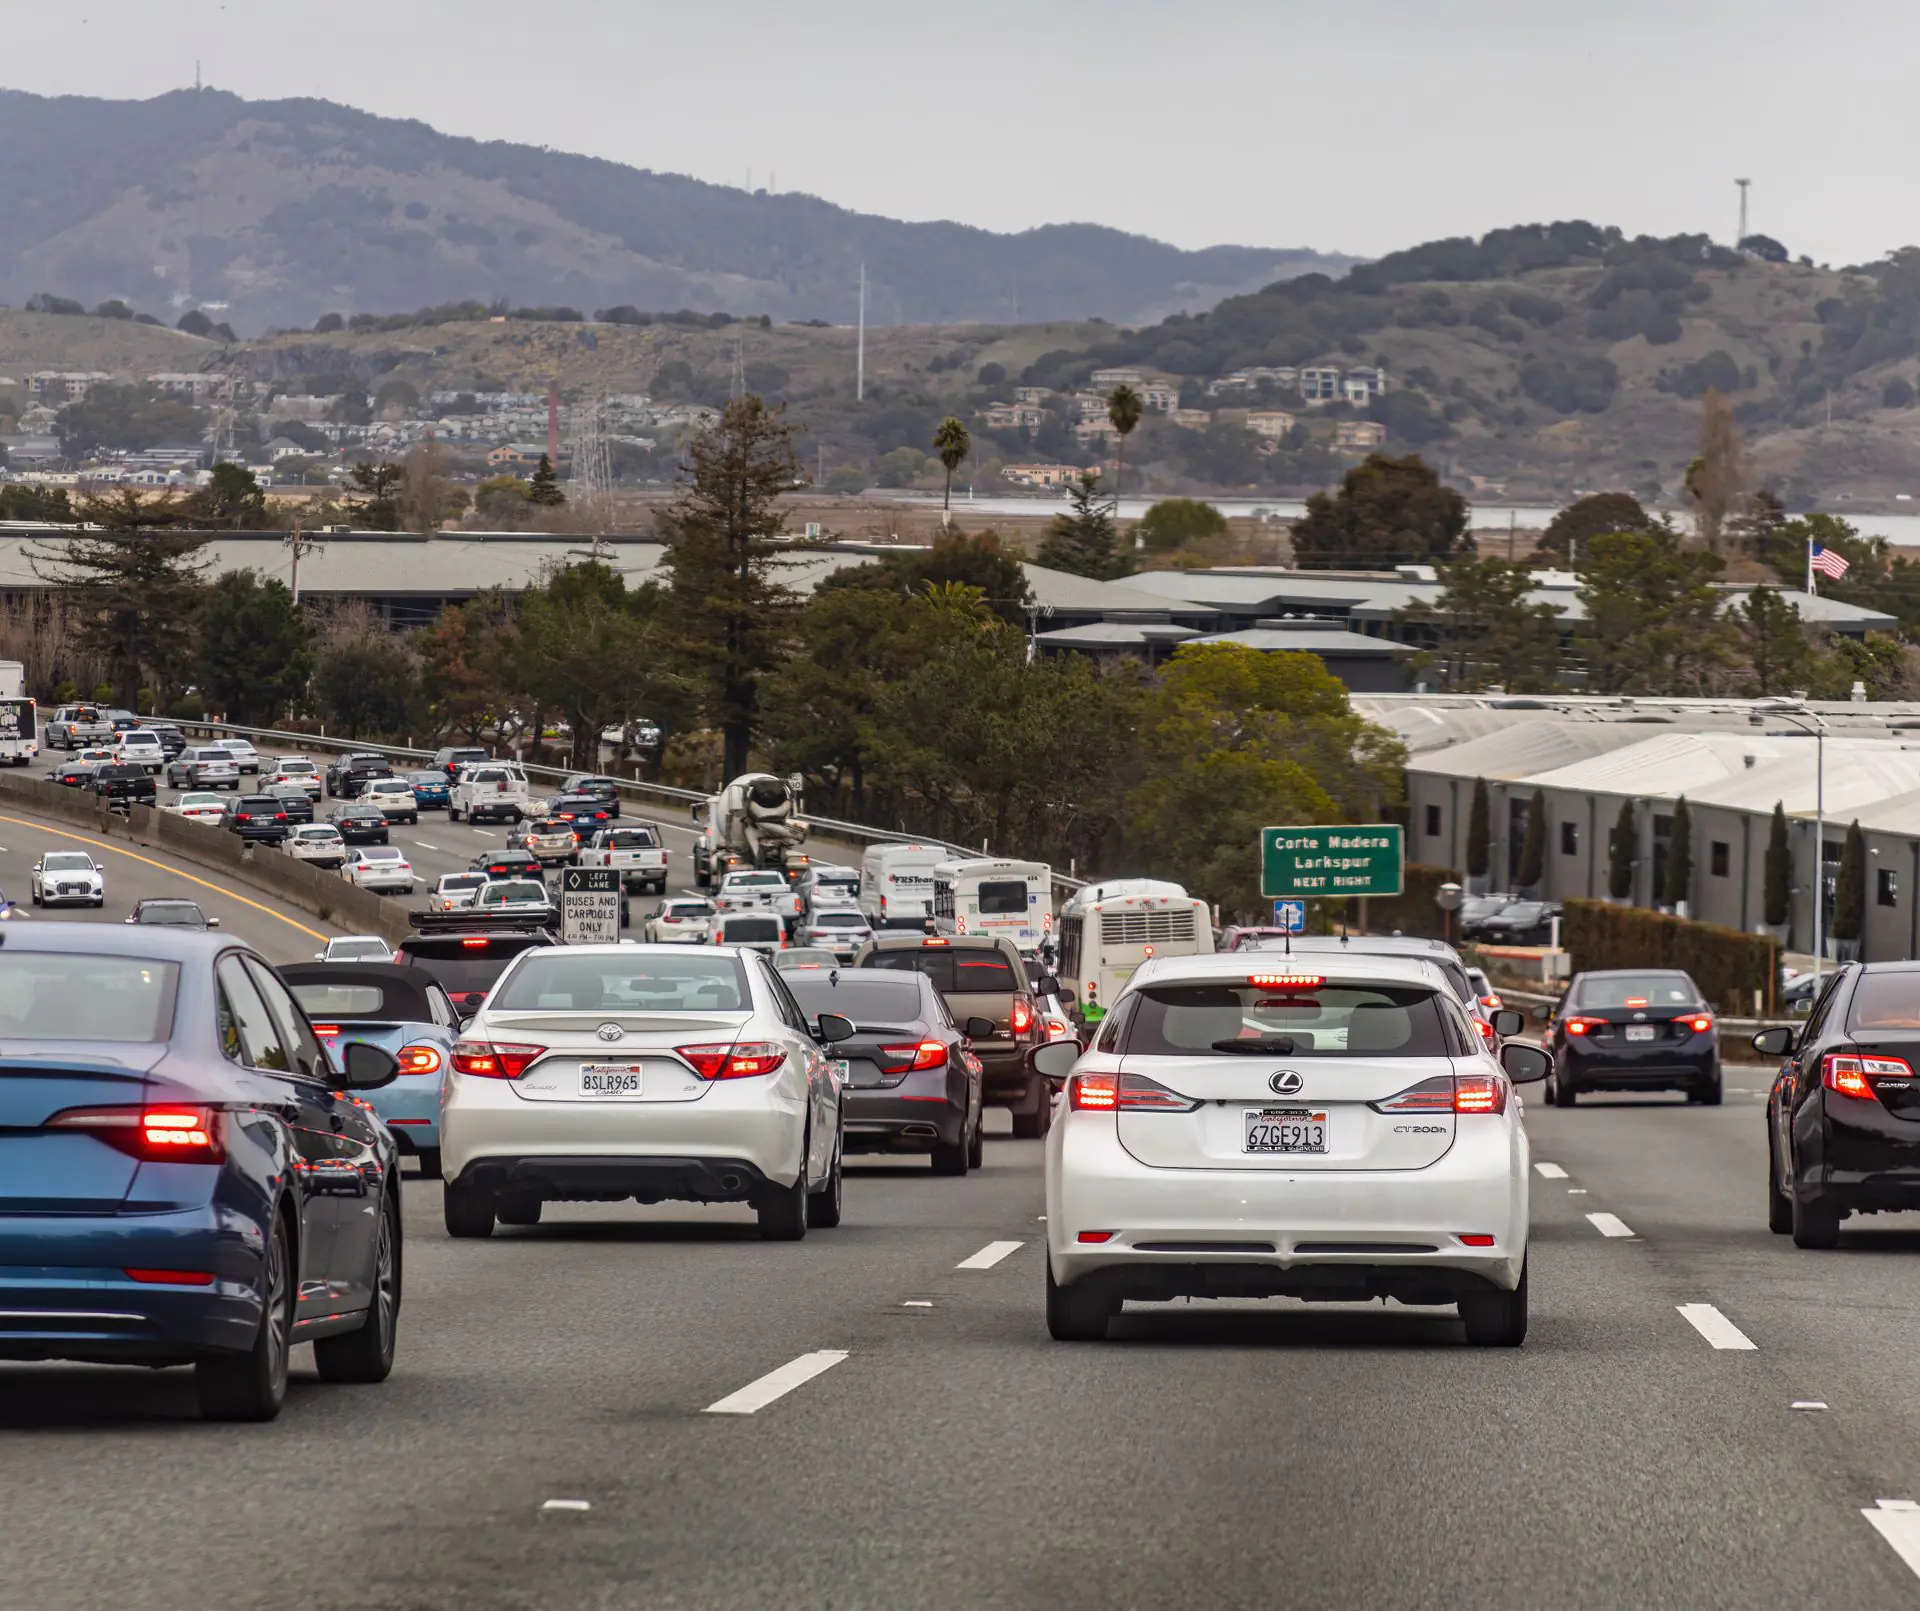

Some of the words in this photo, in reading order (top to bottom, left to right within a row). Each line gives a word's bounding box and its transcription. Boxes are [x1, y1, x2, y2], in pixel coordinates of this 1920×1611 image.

[1275, 837, 1319, 849] Corte
[1328, 836, 1390, 848] Madera
[1295, 856, 1372, 870] Larkspur
[588, 872, 609, 880] LEFT
[1293, 877, 1326, 887] NEXT
[1333, 876, 1372, 886] RIGHT
[566, 896, 595, 906] BUSES
[598, 896, 617, 906] AND
[567, 909, 614, 919] CARPOOLS
[580, 921, 602, 932] ONLY
[583, 1075, 638, 1090] 8SLR965
[1248, 1125, 1323, 1146] 6ZGE913
